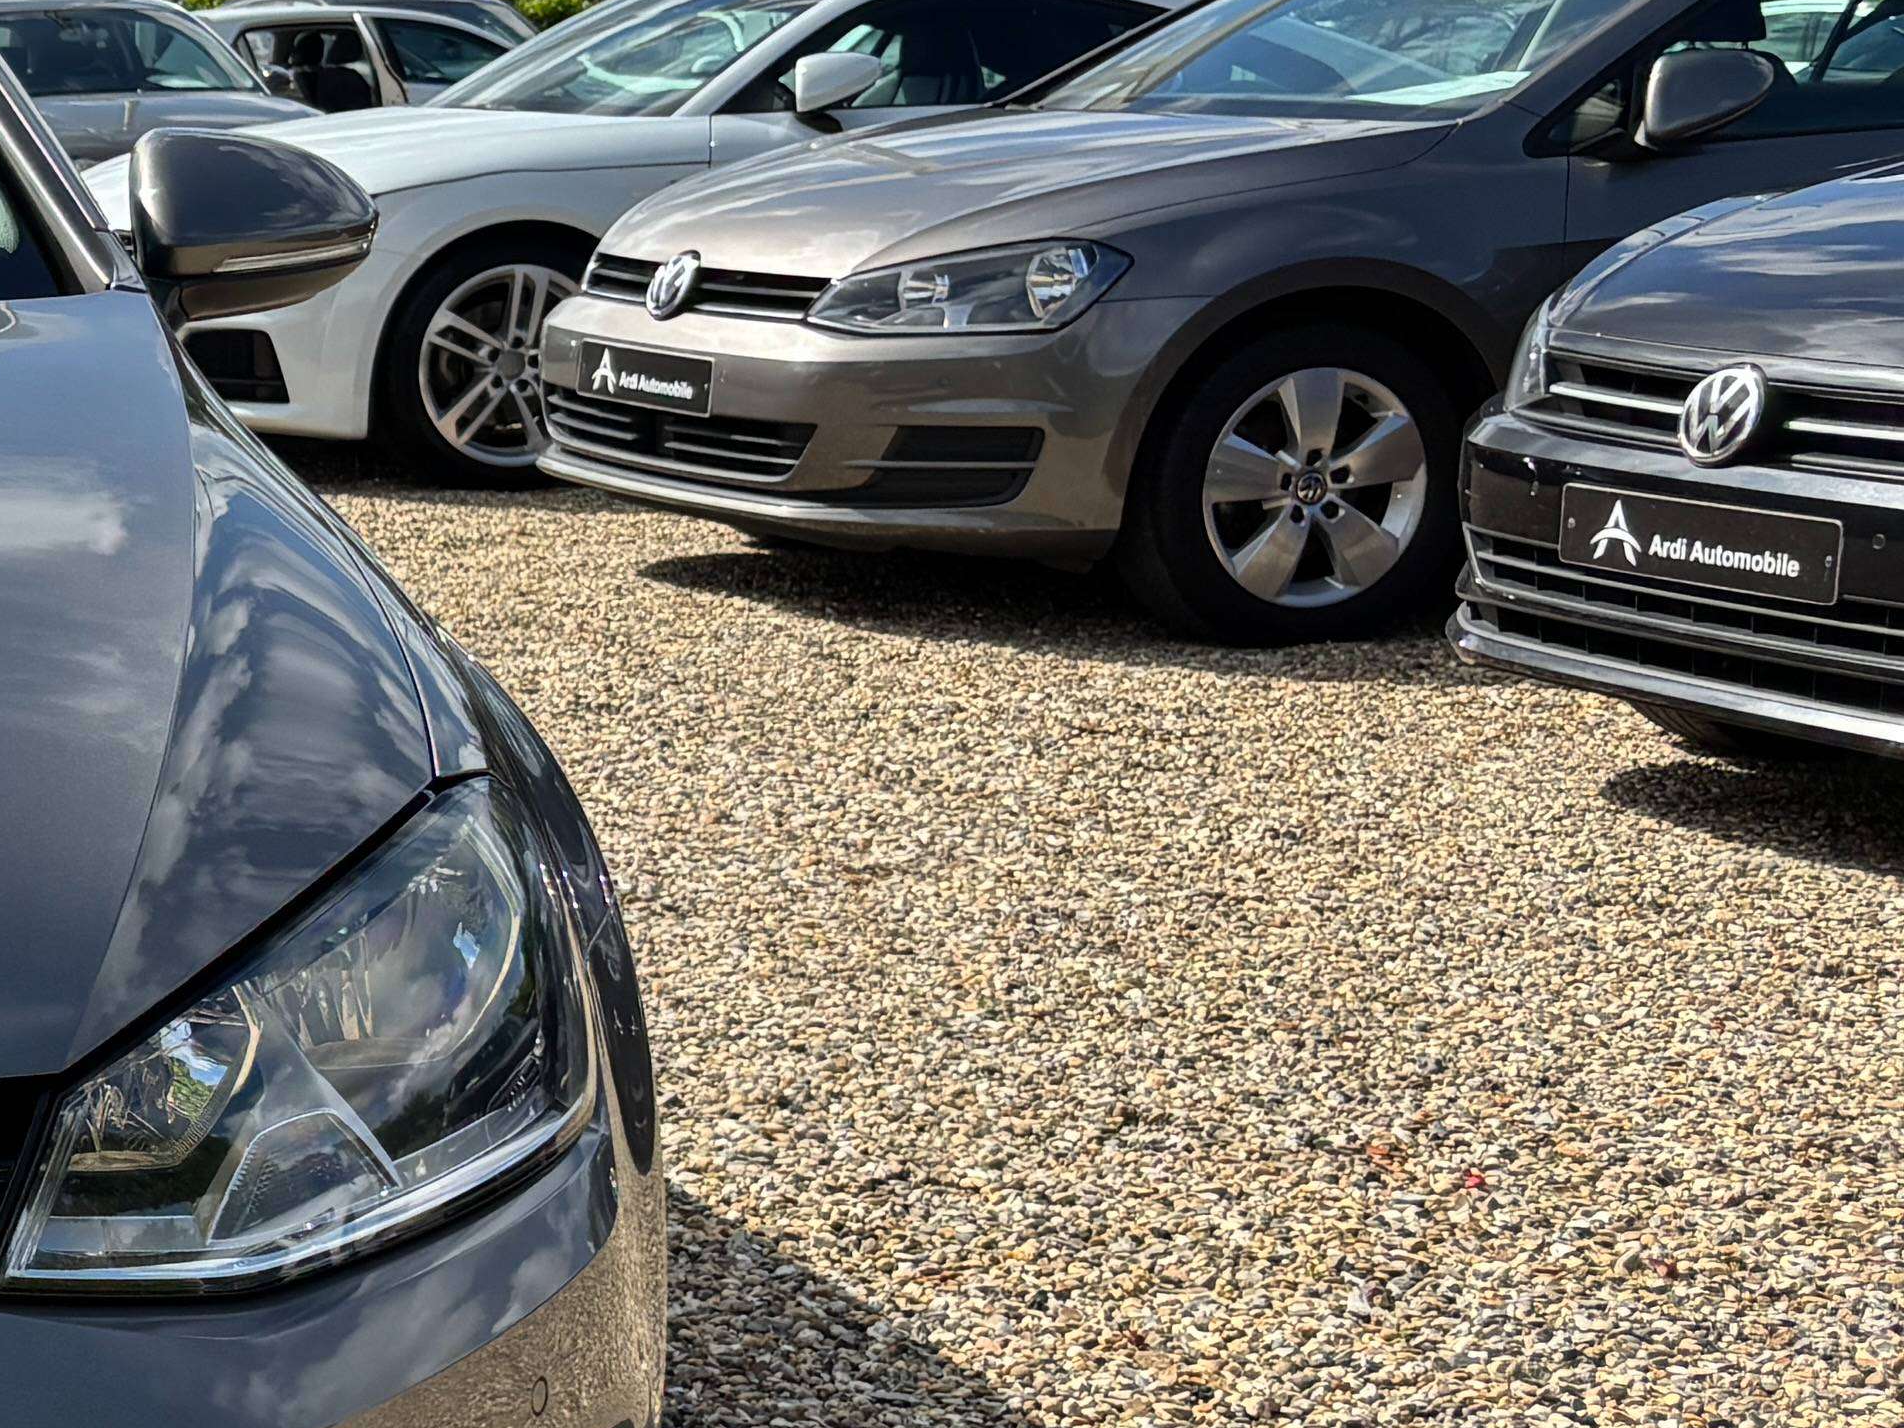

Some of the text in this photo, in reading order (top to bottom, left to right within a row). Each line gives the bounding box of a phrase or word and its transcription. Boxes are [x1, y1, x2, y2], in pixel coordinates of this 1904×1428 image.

[638, 374, 693, 400] Automobile
[1648, 533, 1800, 578] Ardi Automobile
